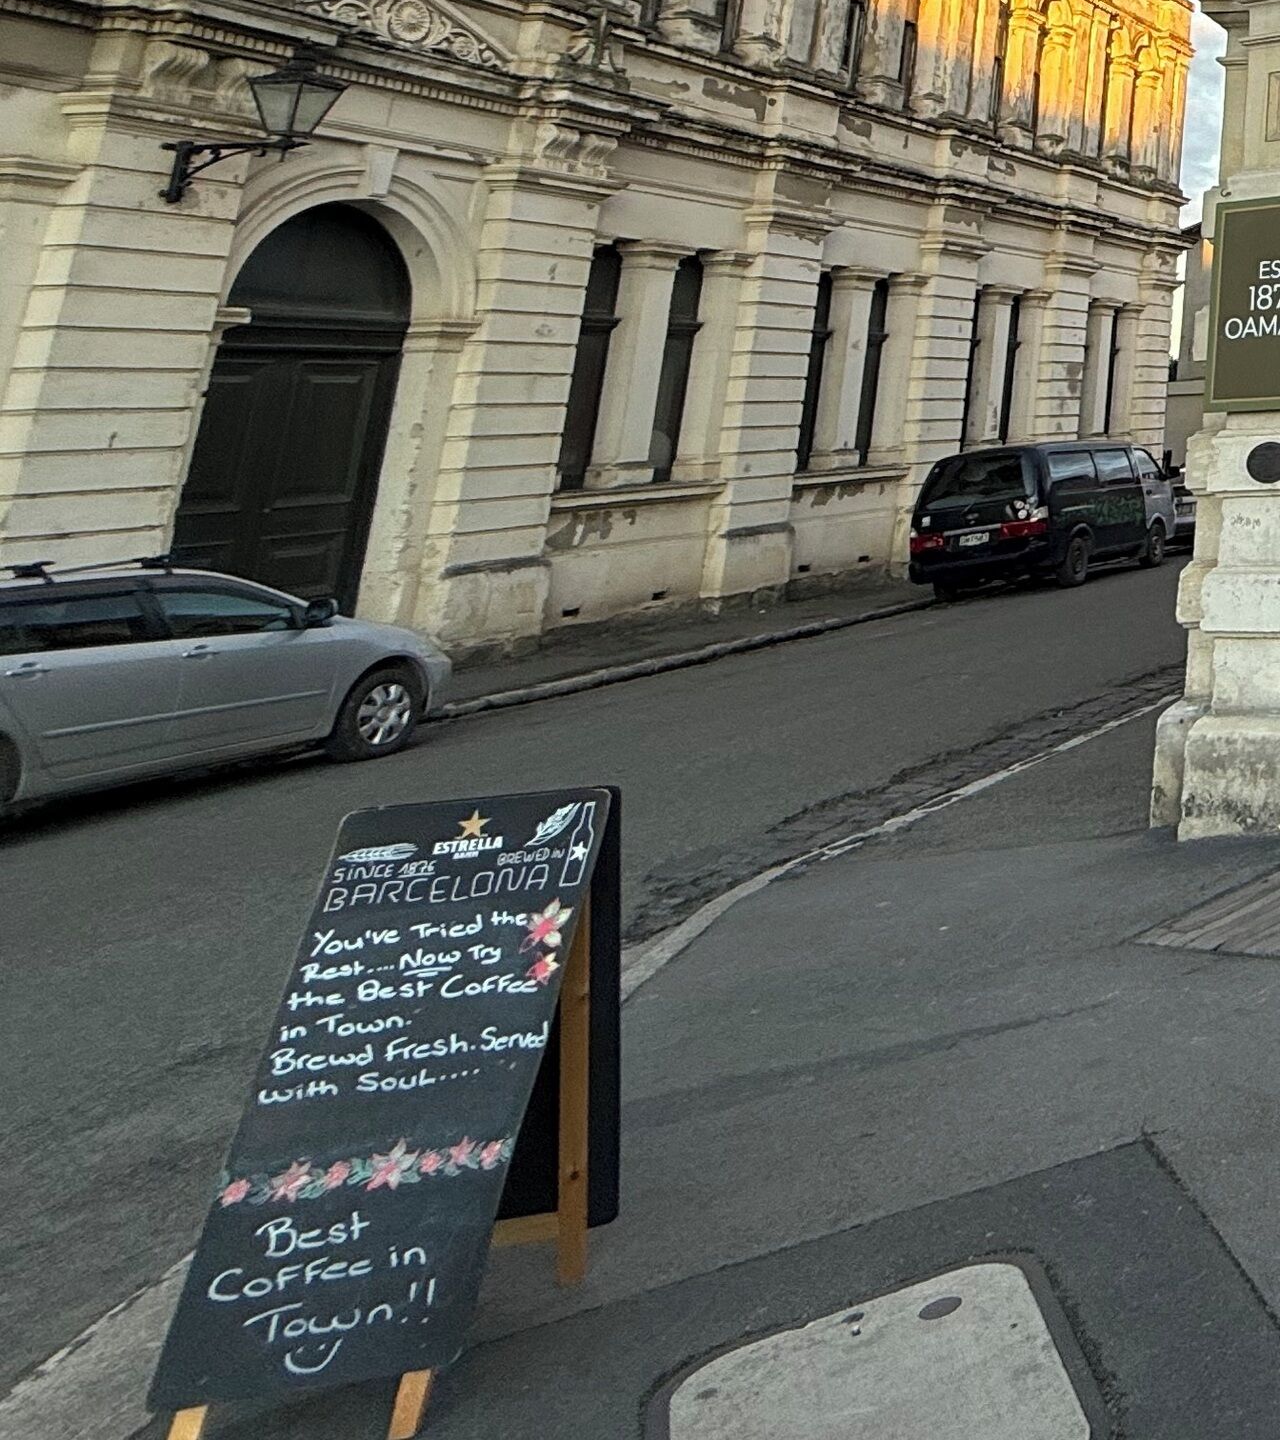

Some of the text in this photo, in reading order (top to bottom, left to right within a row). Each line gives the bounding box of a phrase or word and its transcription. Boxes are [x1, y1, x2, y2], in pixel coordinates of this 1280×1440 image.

[432, 836, 504, 856] ESTRELLA
[497, 847, 550, 866] BREWED
[397, 860, 436, 877] 1876
[323, 864, 549, 912] BARCELONA
[310, 911, 528, 958] You've Tried the
[467, 944, 502, 965] Try
[287, 991, 345, 1011] the
[357, 979, 434, 1002] Best
[279, 1025, 307, 1042] in
[258, 1079, 338, 1106] with
[256, 1213, 370, 1257] Best
[389, 1246, 426, 1267] in
